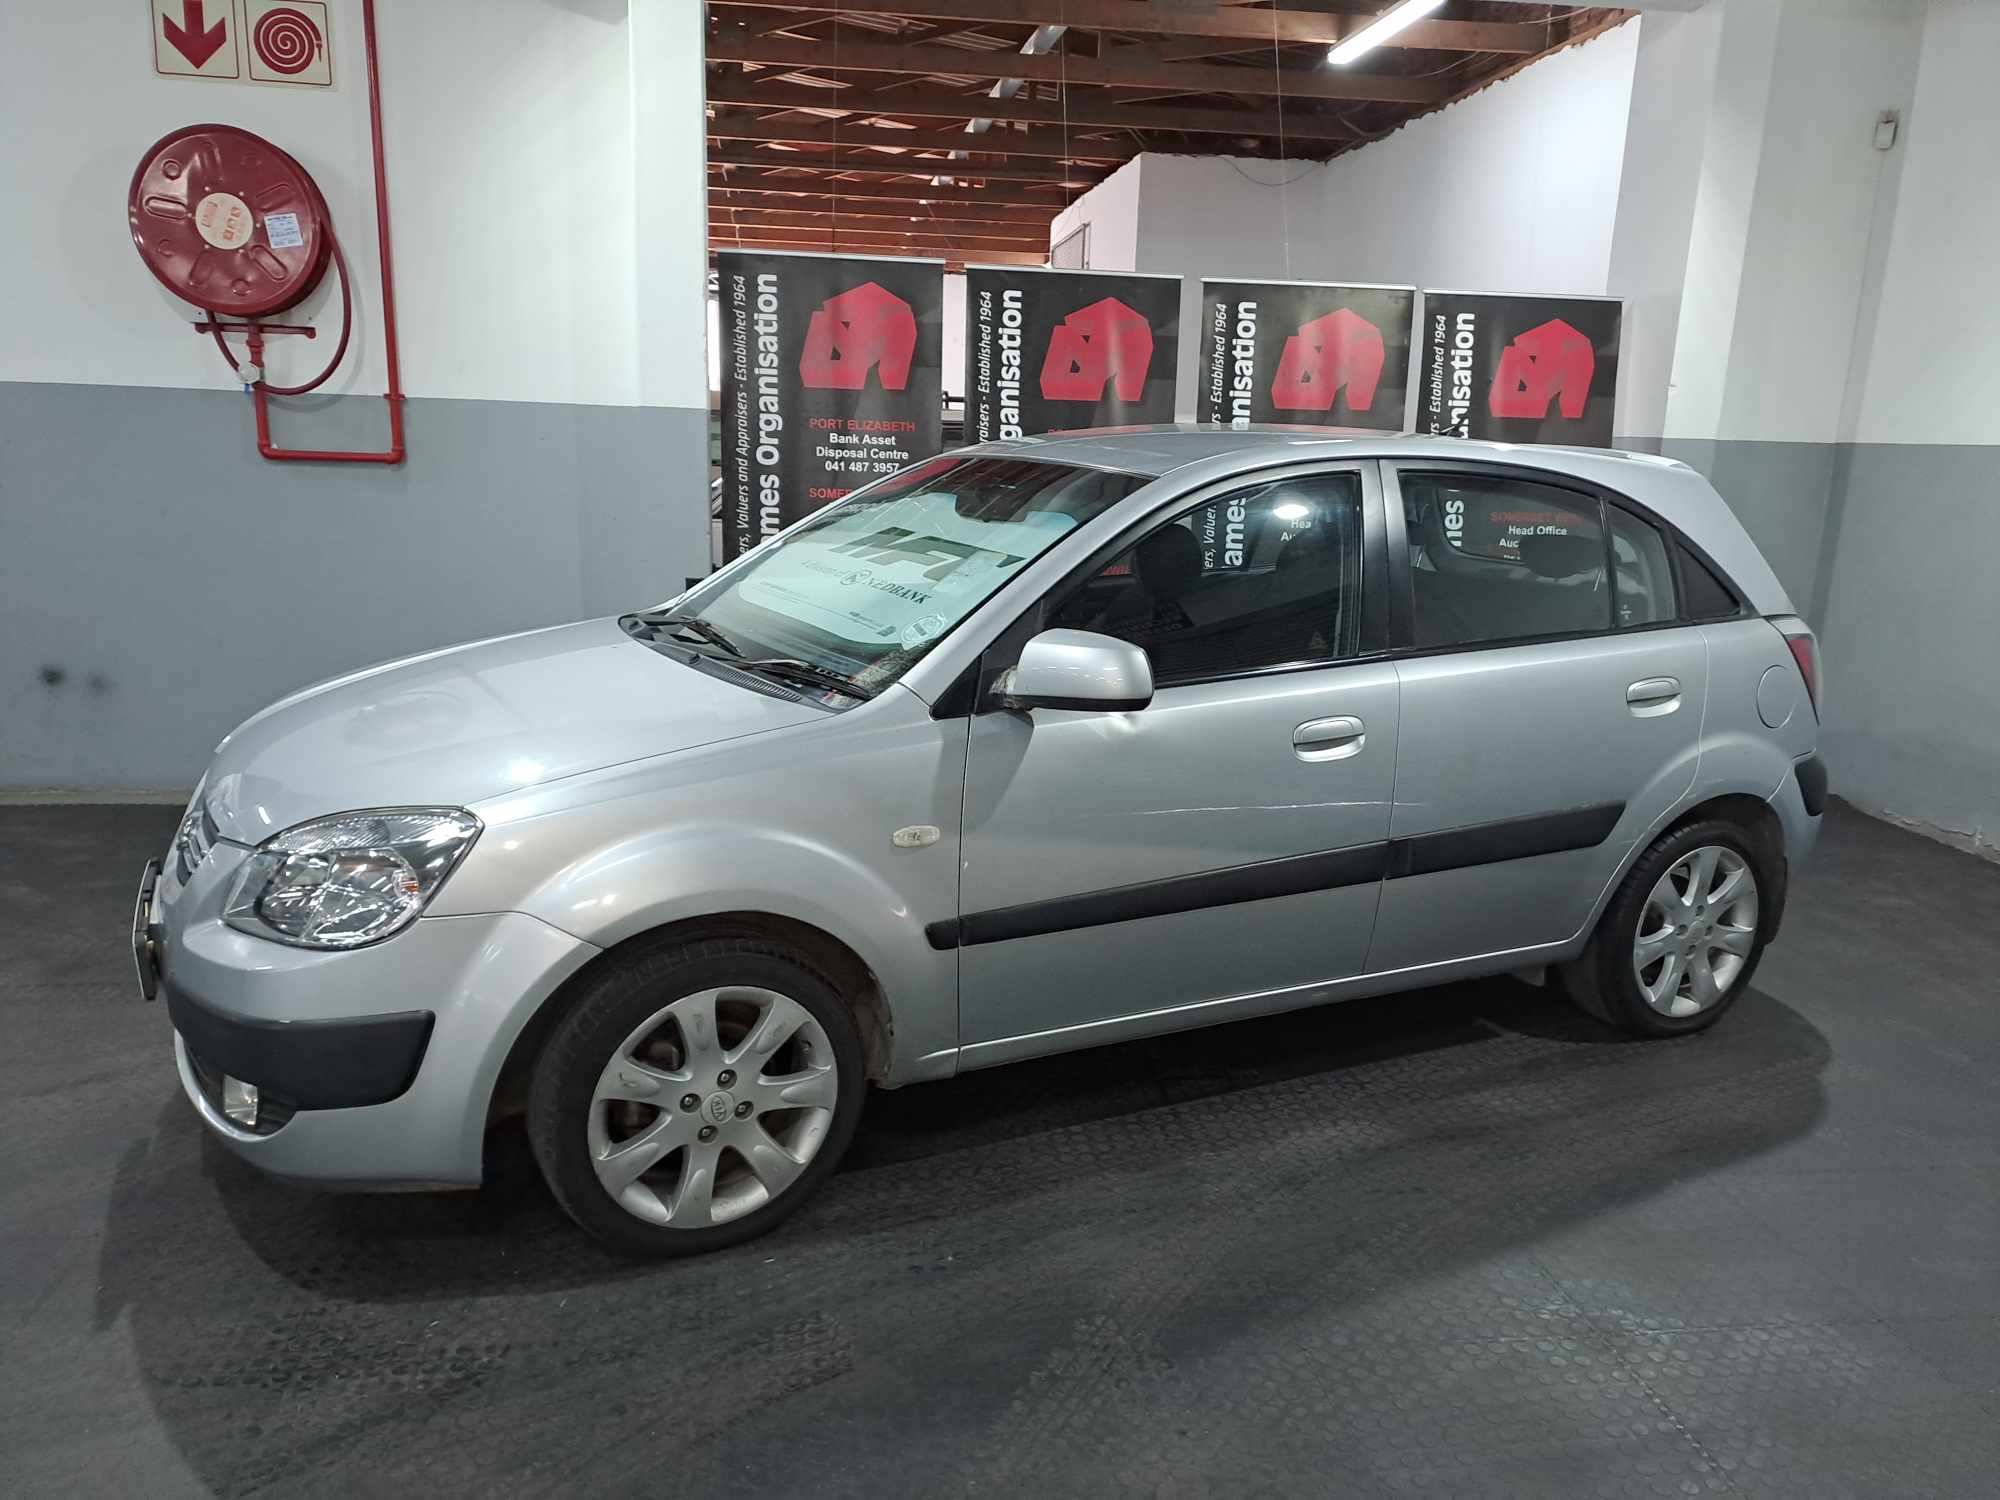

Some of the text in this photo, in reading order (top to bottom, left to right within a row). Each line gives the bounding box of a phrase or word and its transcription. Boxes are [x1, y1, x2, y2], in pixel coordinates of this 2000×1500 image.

[732, 275, 746, 307] 1964
[979, 291, 992, 321] 1964
[1214, 303, 1227, 333] 1964
[1434, 314, 1447, 344] 1964
[732, 311, 748, 381] Established
[977, 324, 991, 393] Established
[754, 273, 783, 466] Organisation
[1210, 336, 1226, 403] Established
[1429, 347, 1445, 413] Established
[735, 392, 751, 455] Appraisers
[809, 418, 917, 433] PORT ELIZABETH
[816, 447, 909, 460] Disposal Centre
[829, 433, 897, 446] Bank Asset
[735, 459, 749, 482] and
[825, 460, 900, 474] 041 487 3957
[736, 485, 750, 529] Valuers
[738, 533, 752, 557] ers,
[1203, 504, 1217, 570] ers, Valuer
[1508, 525, 1568, 537] Head Office
